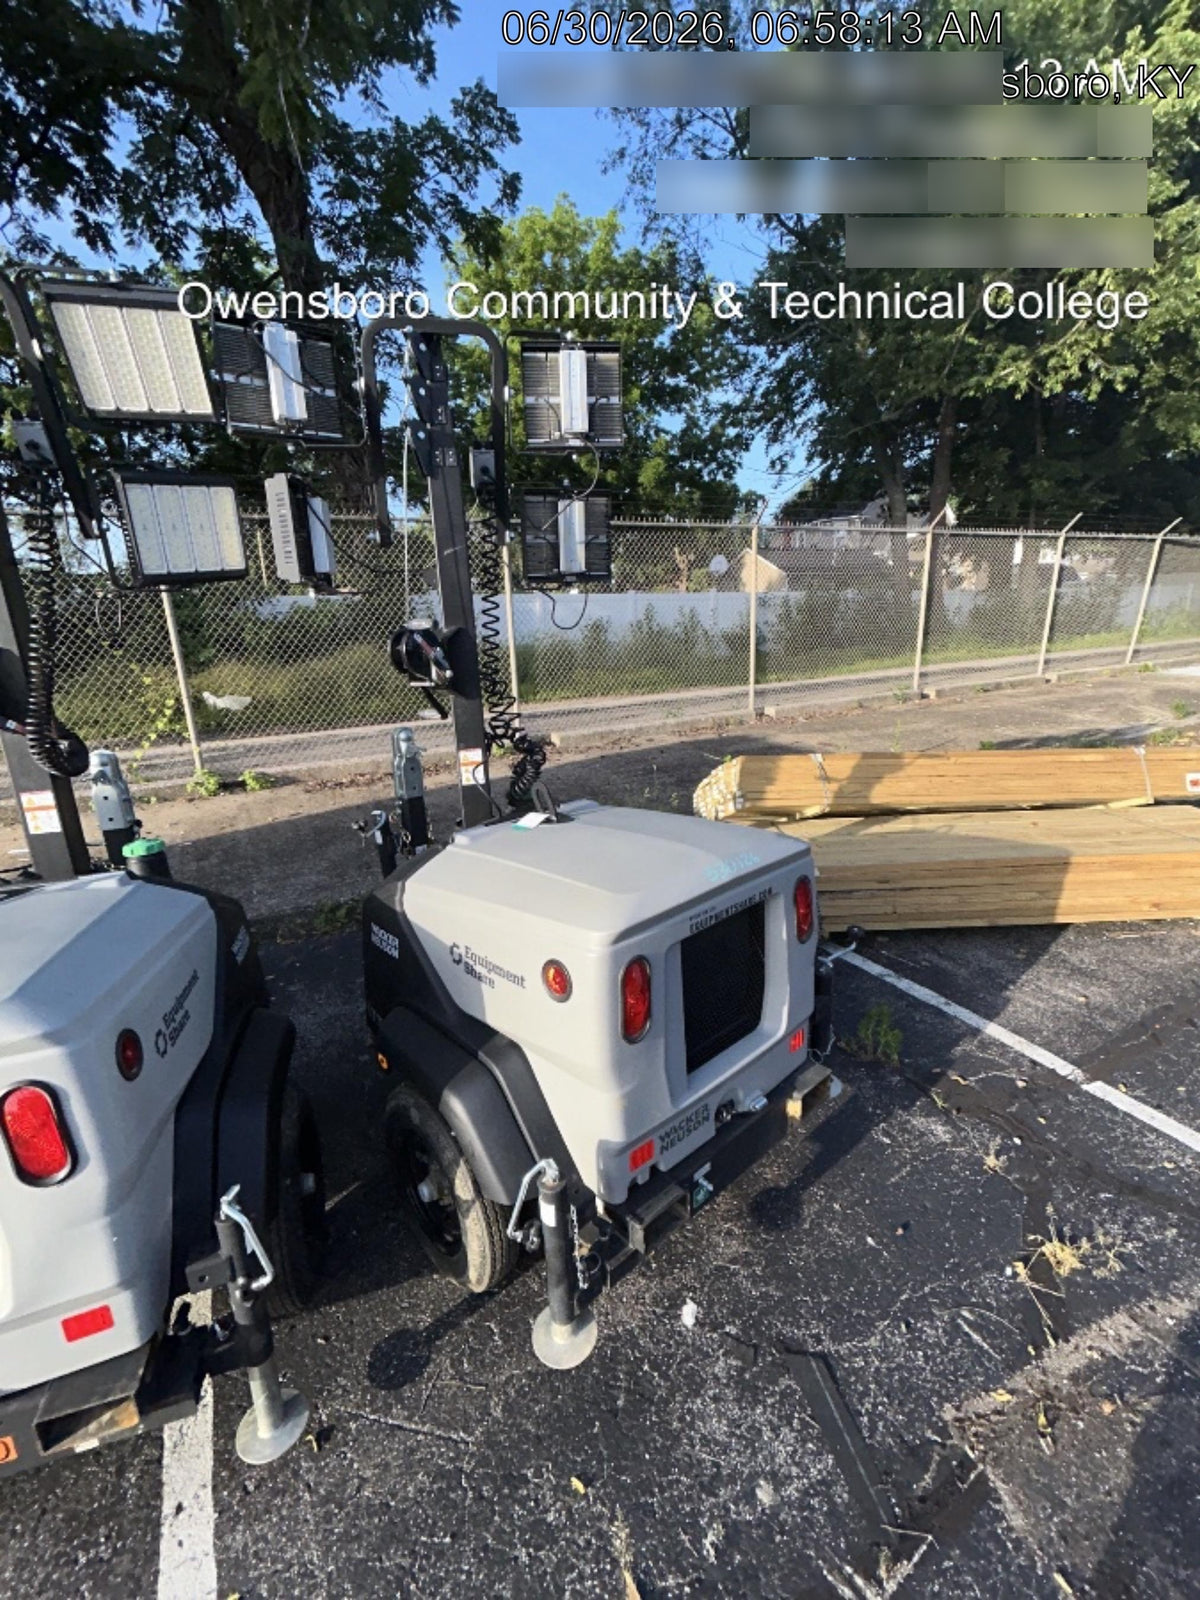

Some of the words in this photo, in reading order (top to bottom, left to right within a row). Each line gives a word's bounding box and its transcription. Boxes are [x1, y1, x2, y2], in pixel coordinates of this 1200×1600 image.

[464, 945, 526, 988] Equipment
[464, 961, 495, 989] Share
[659, 1103, 709, 1142] WACKER
[660, 1112, 710, 1155] NEUSON
